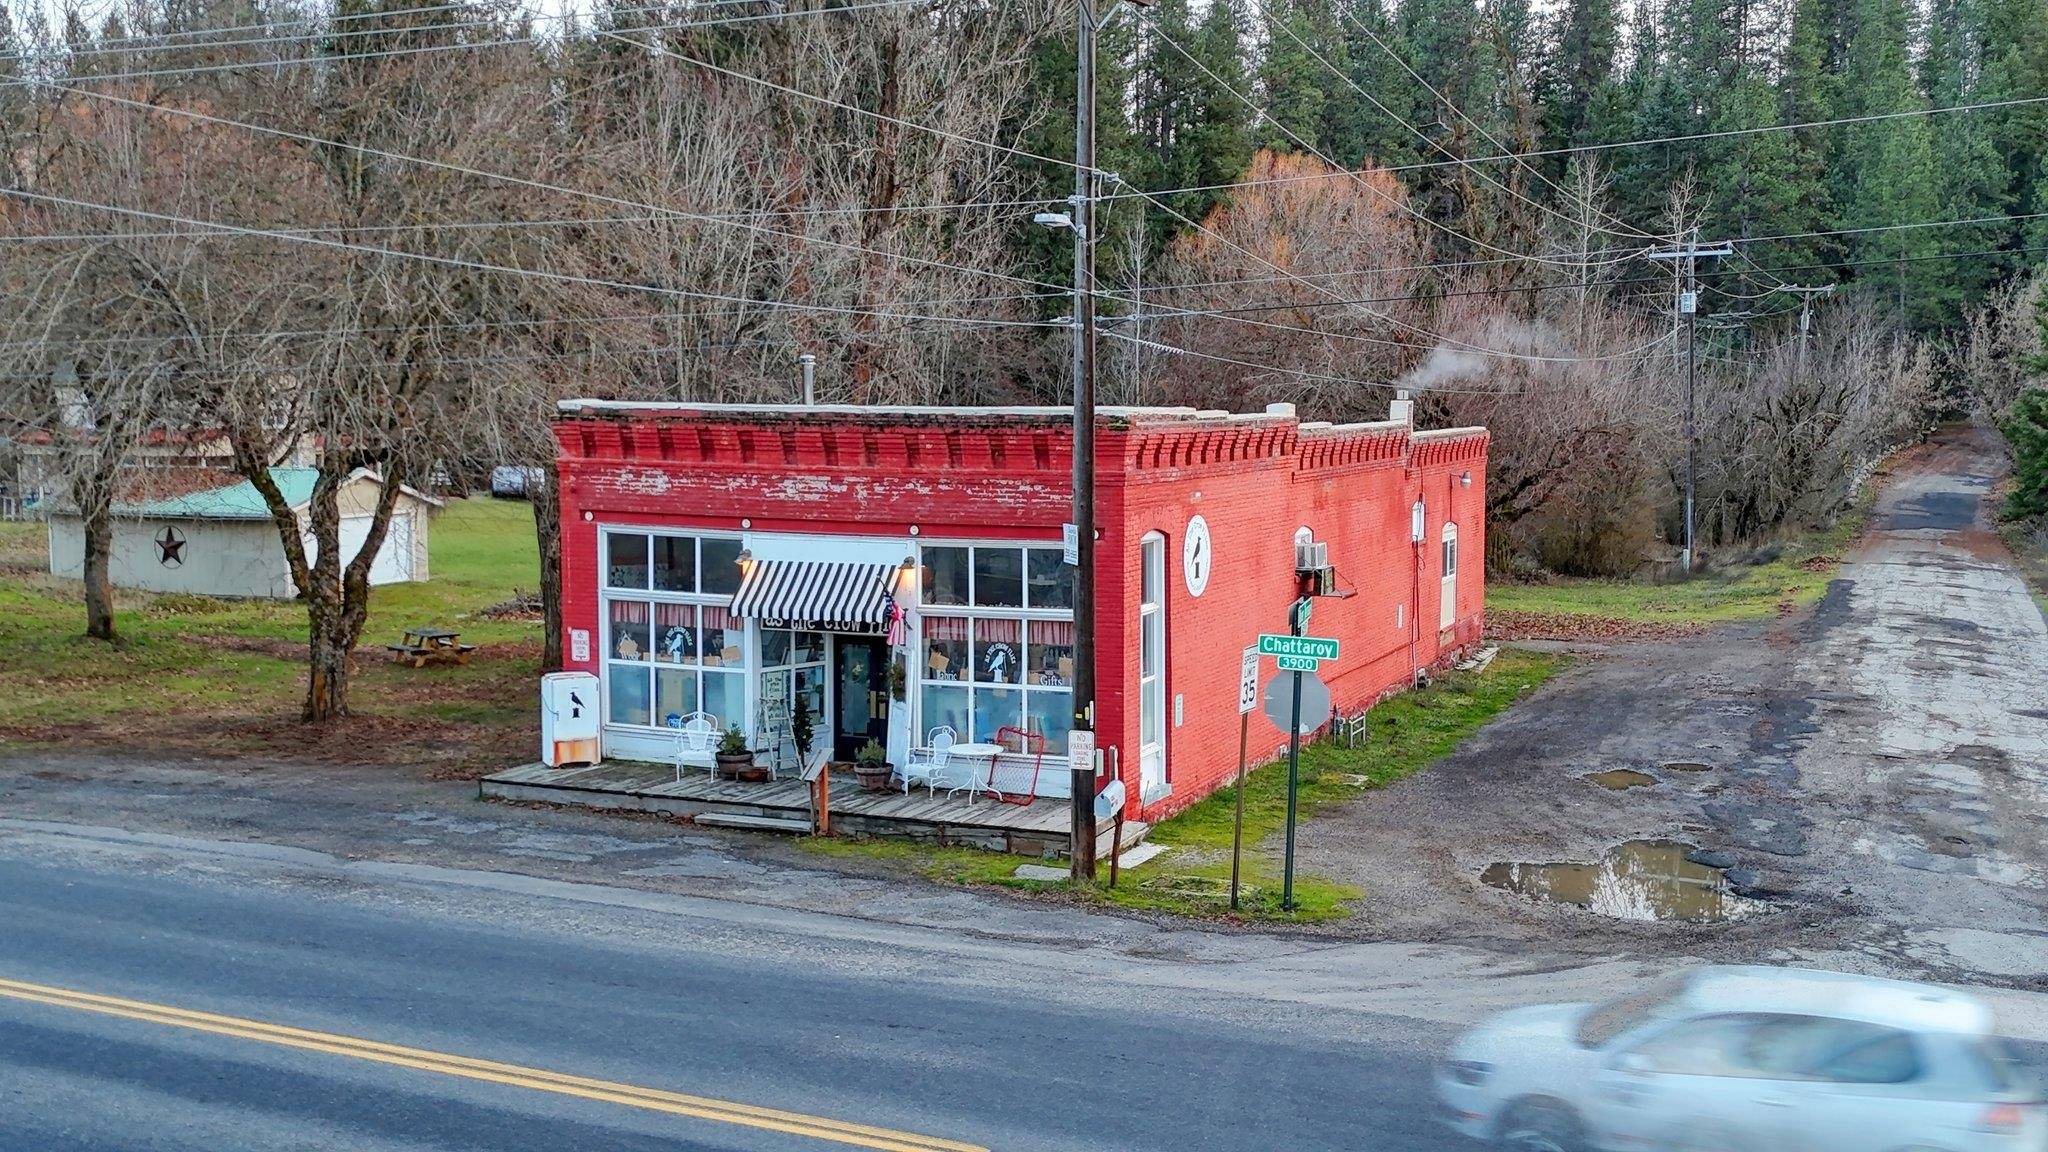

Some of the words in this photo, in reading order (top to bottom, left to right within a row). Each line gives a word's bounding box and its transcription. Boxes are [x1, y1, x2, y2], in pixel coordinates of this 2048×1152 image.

[1263, 637, 1334, 658] Chattaroy
[1283, 657, 1313, 670] 3900
[1039, 674, 1063, 686] Gifts
[1242, 679, 1256, 705] 35
[1076, 734, 1087, 743] NO
